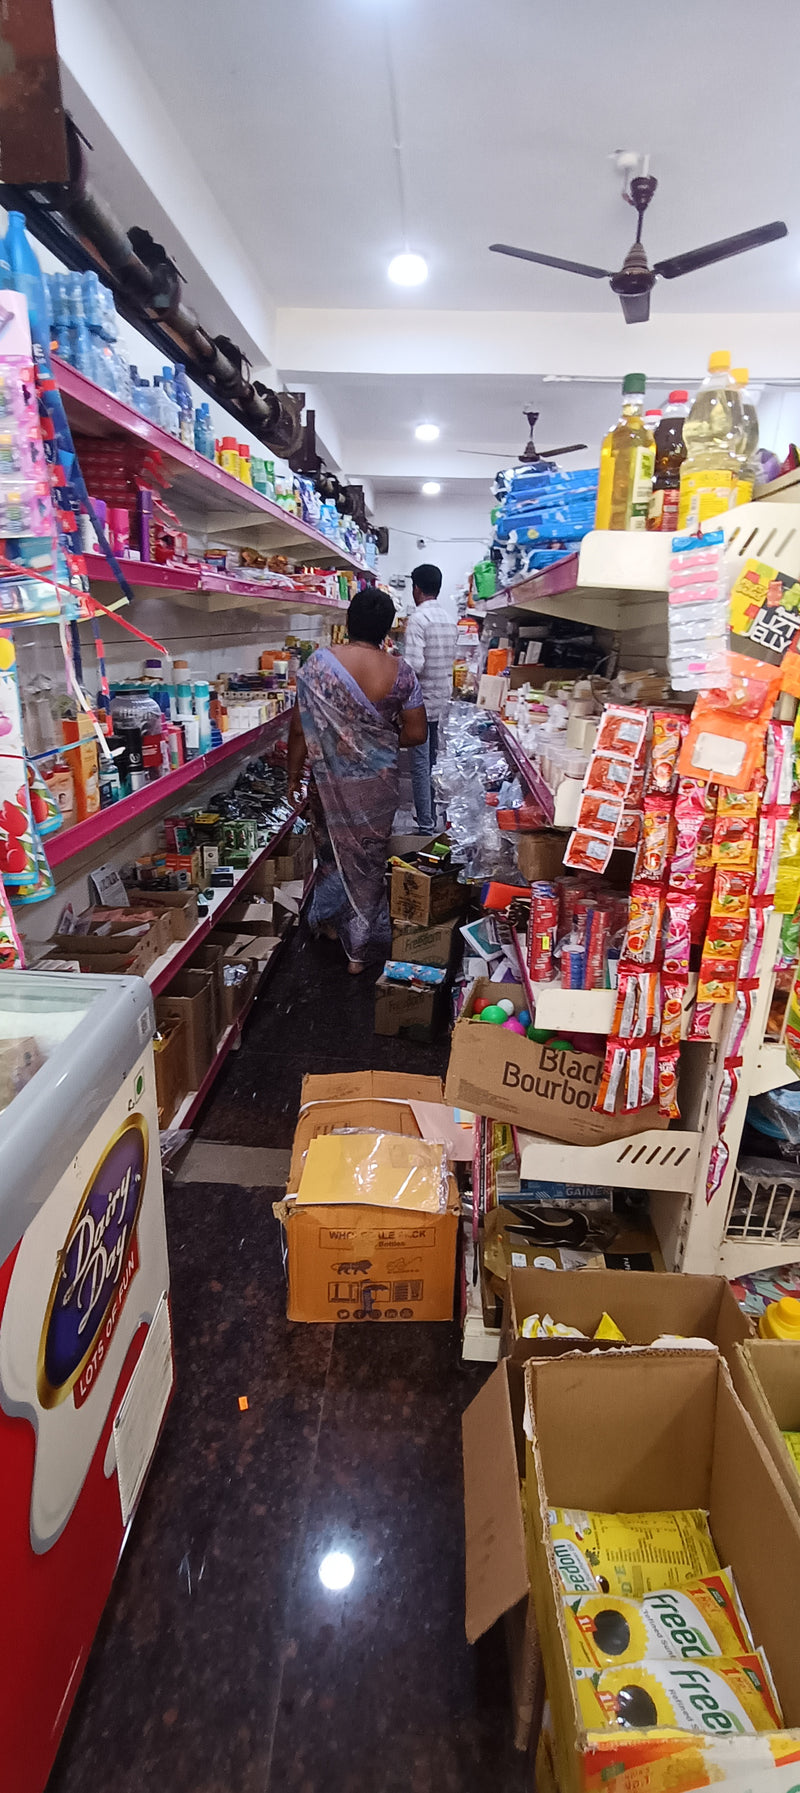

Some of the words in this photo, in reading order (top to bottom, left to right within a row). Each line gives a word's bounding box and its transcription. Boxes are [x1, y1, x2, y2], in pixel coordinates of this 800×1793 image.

[63, 1166, 131, 1306] Dairy
[77, 1223, 128, 1335] Day
[79, 1340, 104, 1396] LOTS
[105, 1306, 118, 1338] OF
[118, 1251, 136, 1304] FUN
[670, 1669, 733, 1736] Free
